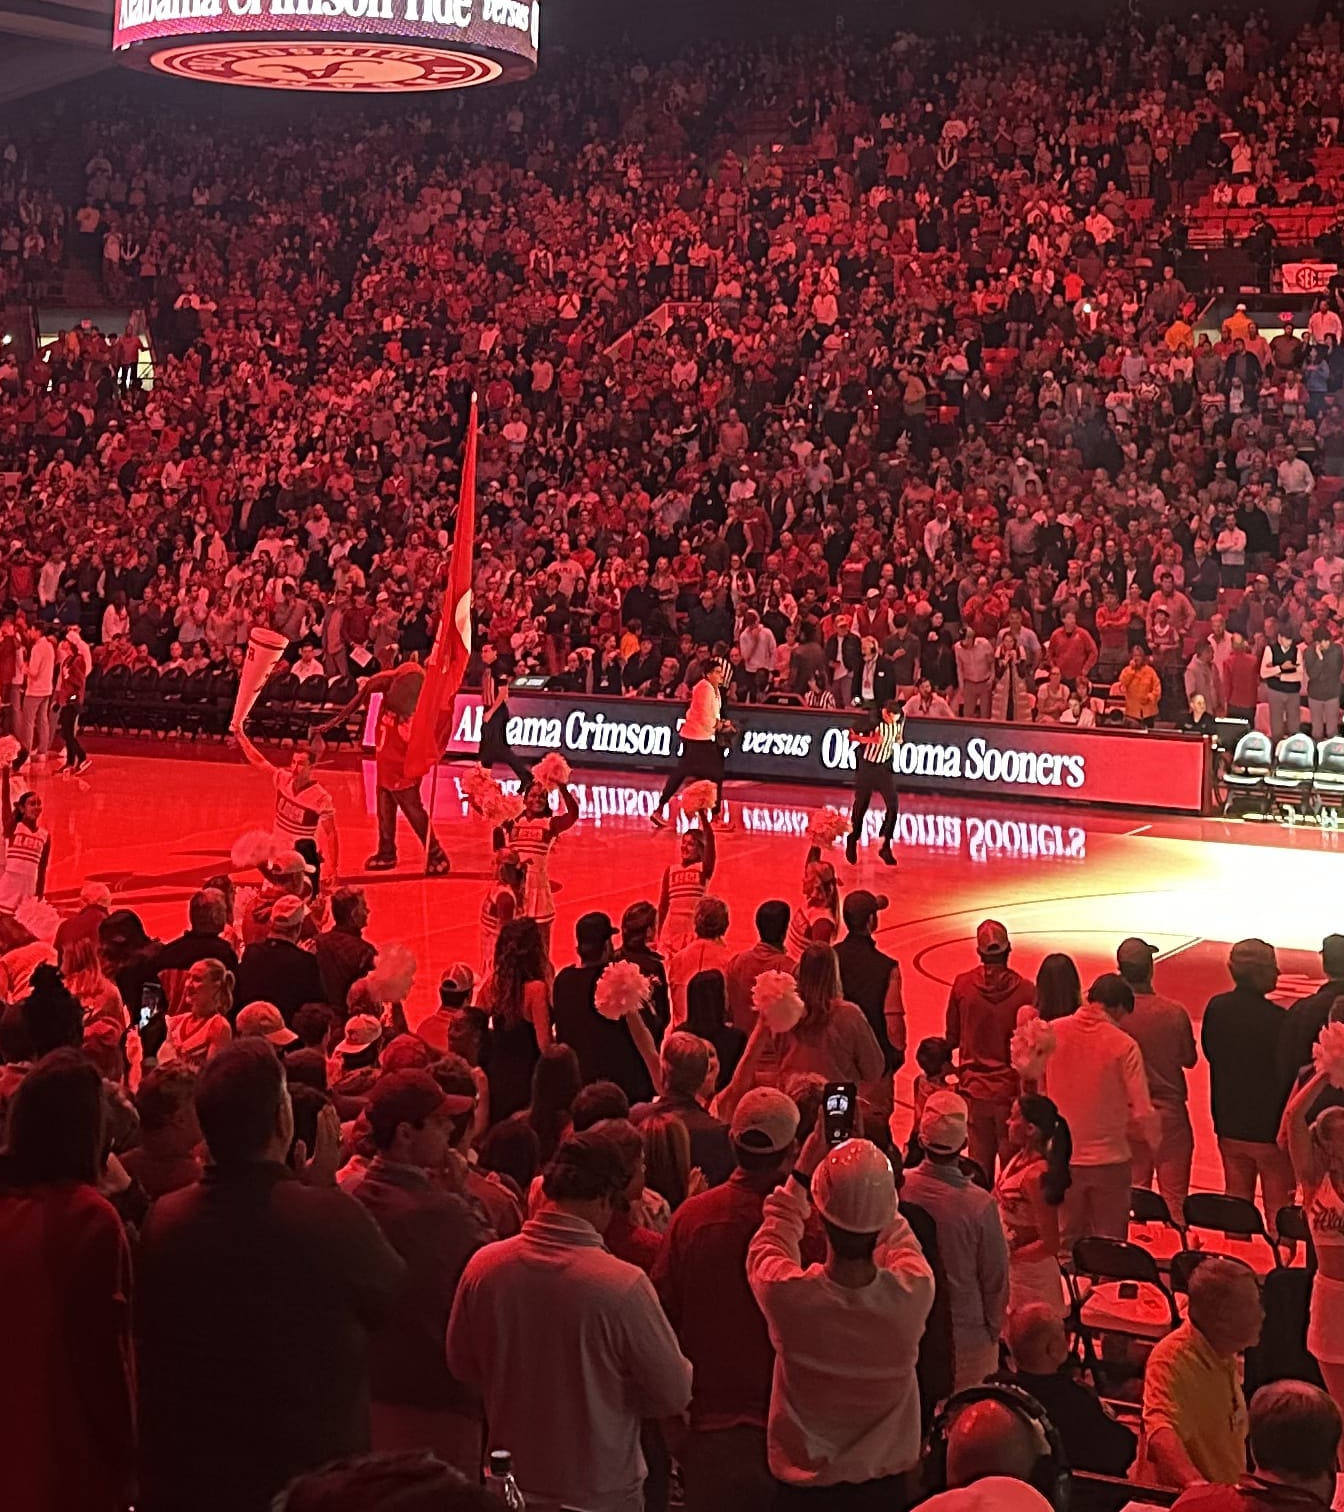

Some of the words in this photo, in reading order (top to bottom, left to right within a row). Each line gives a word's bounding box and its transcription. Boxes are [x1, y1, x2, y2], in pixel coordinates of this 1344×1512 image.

[1297, 268, 1316, 288] SEC
[454, 704, 561, 748] Alama
[565, 711, 671, 756] Crimson
[742, 730, 812, 757] versus
[964, 737, 1086, 788] Sooners
